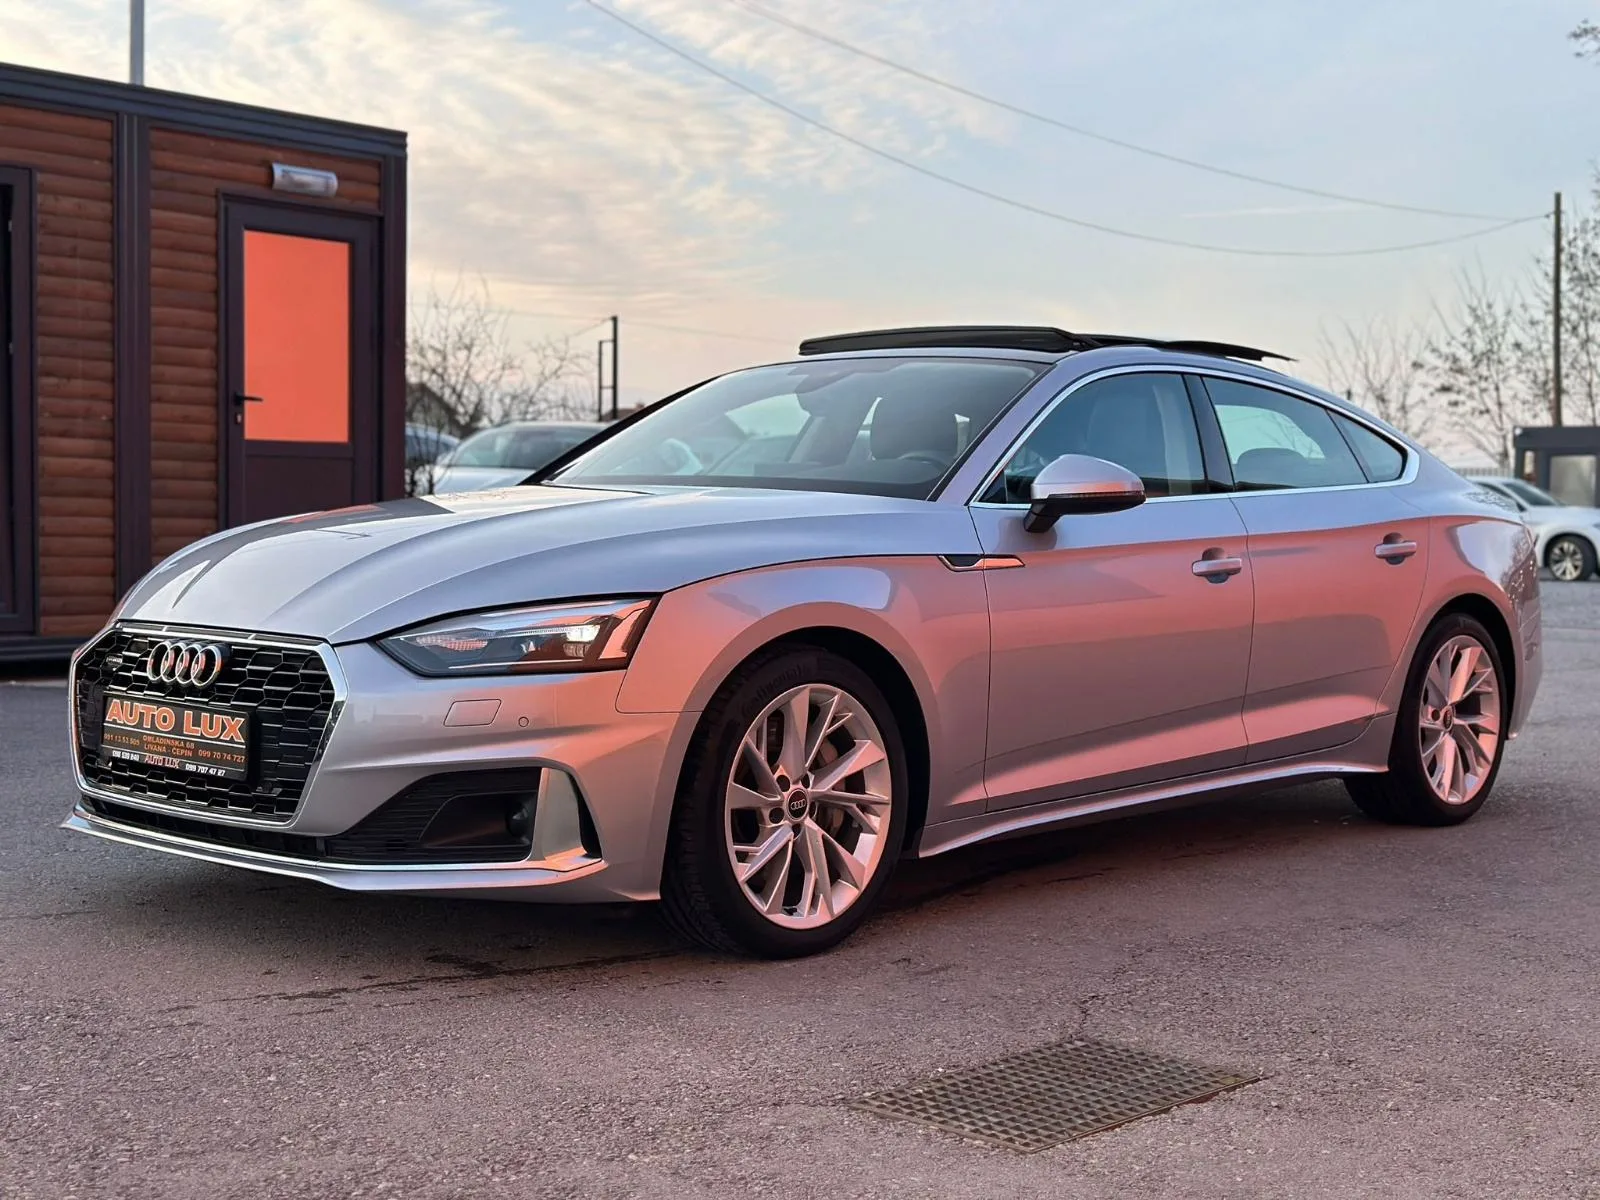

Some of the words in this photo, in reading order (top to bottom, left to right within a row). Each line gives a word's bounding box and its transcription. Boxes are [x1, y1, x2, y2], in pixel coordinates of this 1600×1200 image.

[105, 699, 176, 731] AUTO
[183, 711, 245, 742] LUX
[144, 754, 164, 765] AUTO
[165, 757, 181, 769] LUX
[198, 749, 211, 758] 099
[213, 751, 221, 760] 70
[233, 754, 245, 763] 727
[185, 763, 197, 772] 099
[197, 765, 209, 773] 707
